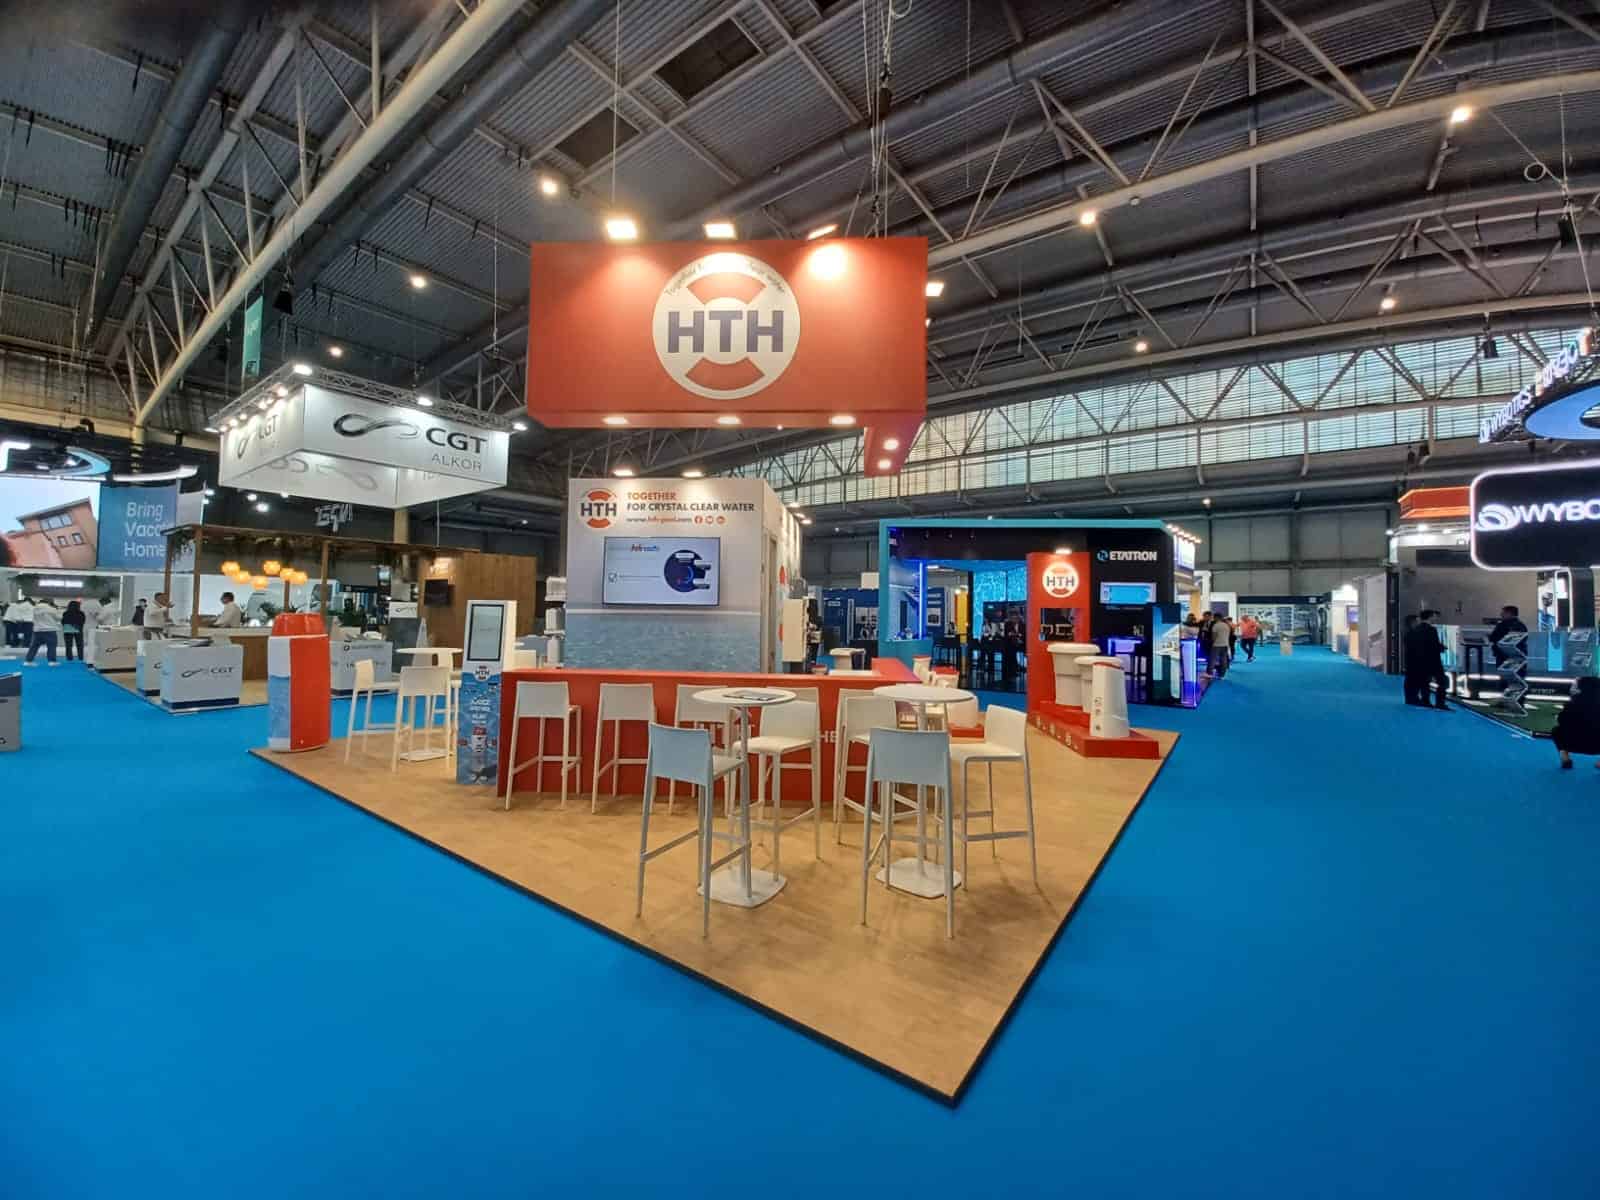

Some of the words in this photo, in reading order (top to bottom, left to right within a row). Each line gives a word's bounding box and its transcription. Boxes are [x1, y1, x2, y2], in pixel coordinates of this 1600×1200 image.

[667, 310, 784, 353] HTH
[425, 427, 487, 454] CGT
[431, 452, 482, 473] ALKOR
[627, 492, 676, 501] TOGETHER
[127, 501, 163, 522] Bring
[580, 502, 617, 517] HTH
[627, 503, 645, 512] FOR
[647, 503, 688, 512] CRYSTAL
[690, 503, 719, 511] CLEAR
[722, 503, 755, 511] WATER
[124, 521, 167, 537] Vaca
[1109, 551, 1157, 560] ETATRON
[1046, 575, 1075, 587] HTH
